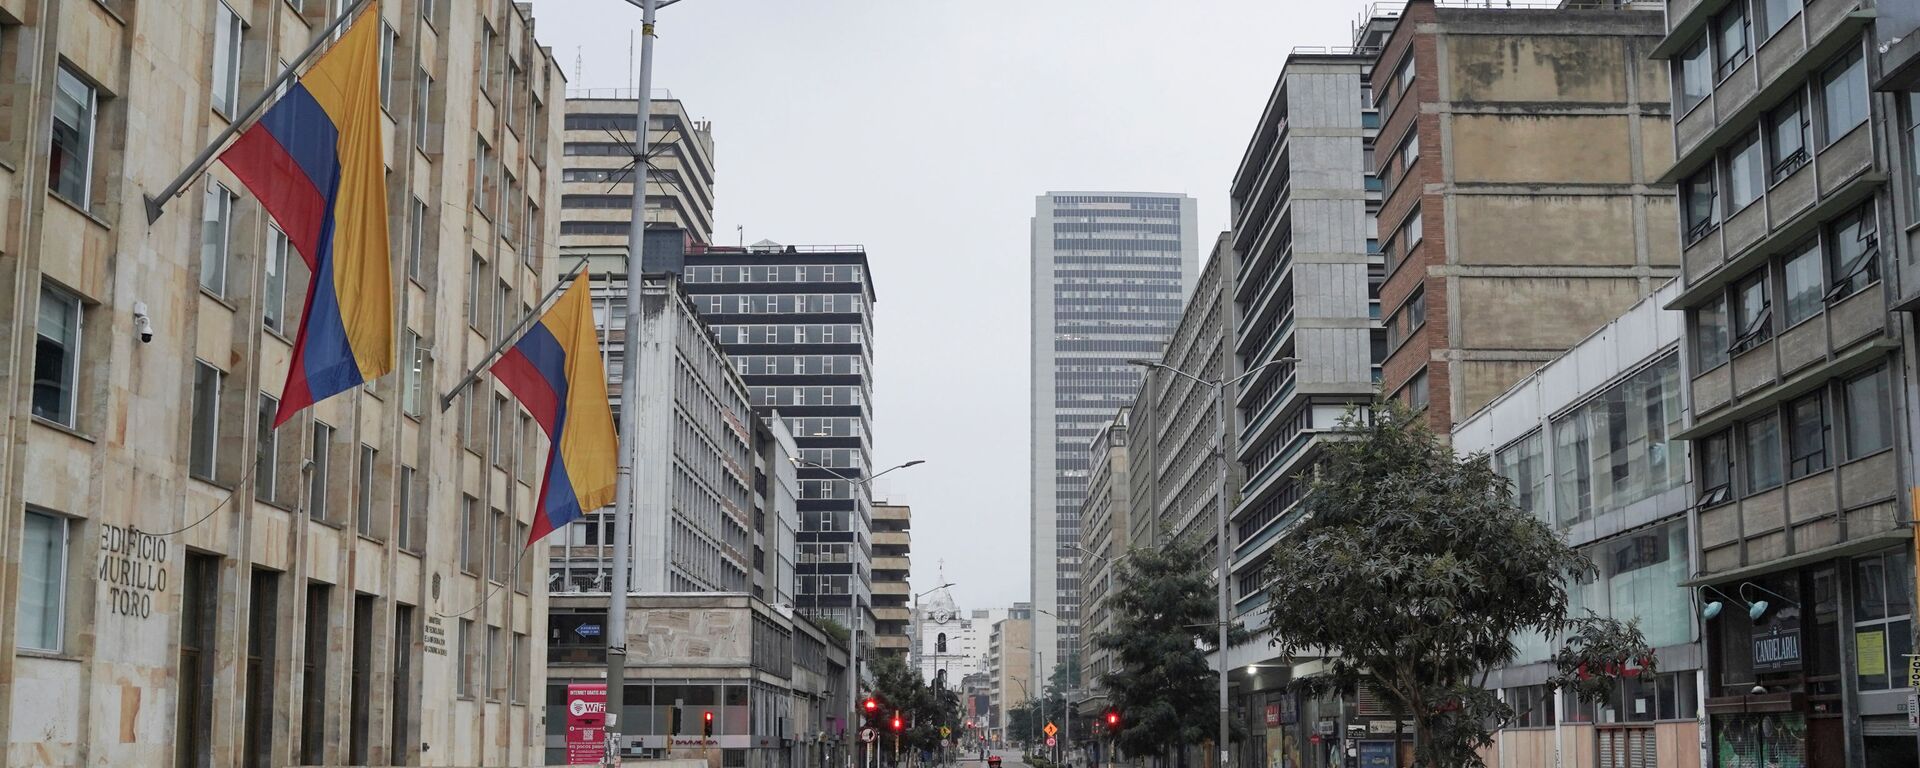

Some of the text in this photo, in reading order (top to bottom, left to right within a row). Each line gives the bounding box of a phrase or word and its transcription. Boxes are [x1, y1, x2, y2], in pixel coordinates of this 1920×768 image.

[101, 523, 166, 563] EDIFICIO
[99, 555, 166, 592] MURILLO
[110, 587, 150, 619] TORO
[1755, 636, 1798, 662] CANDELARIA
[585, 703, 606, 713] WiFi
